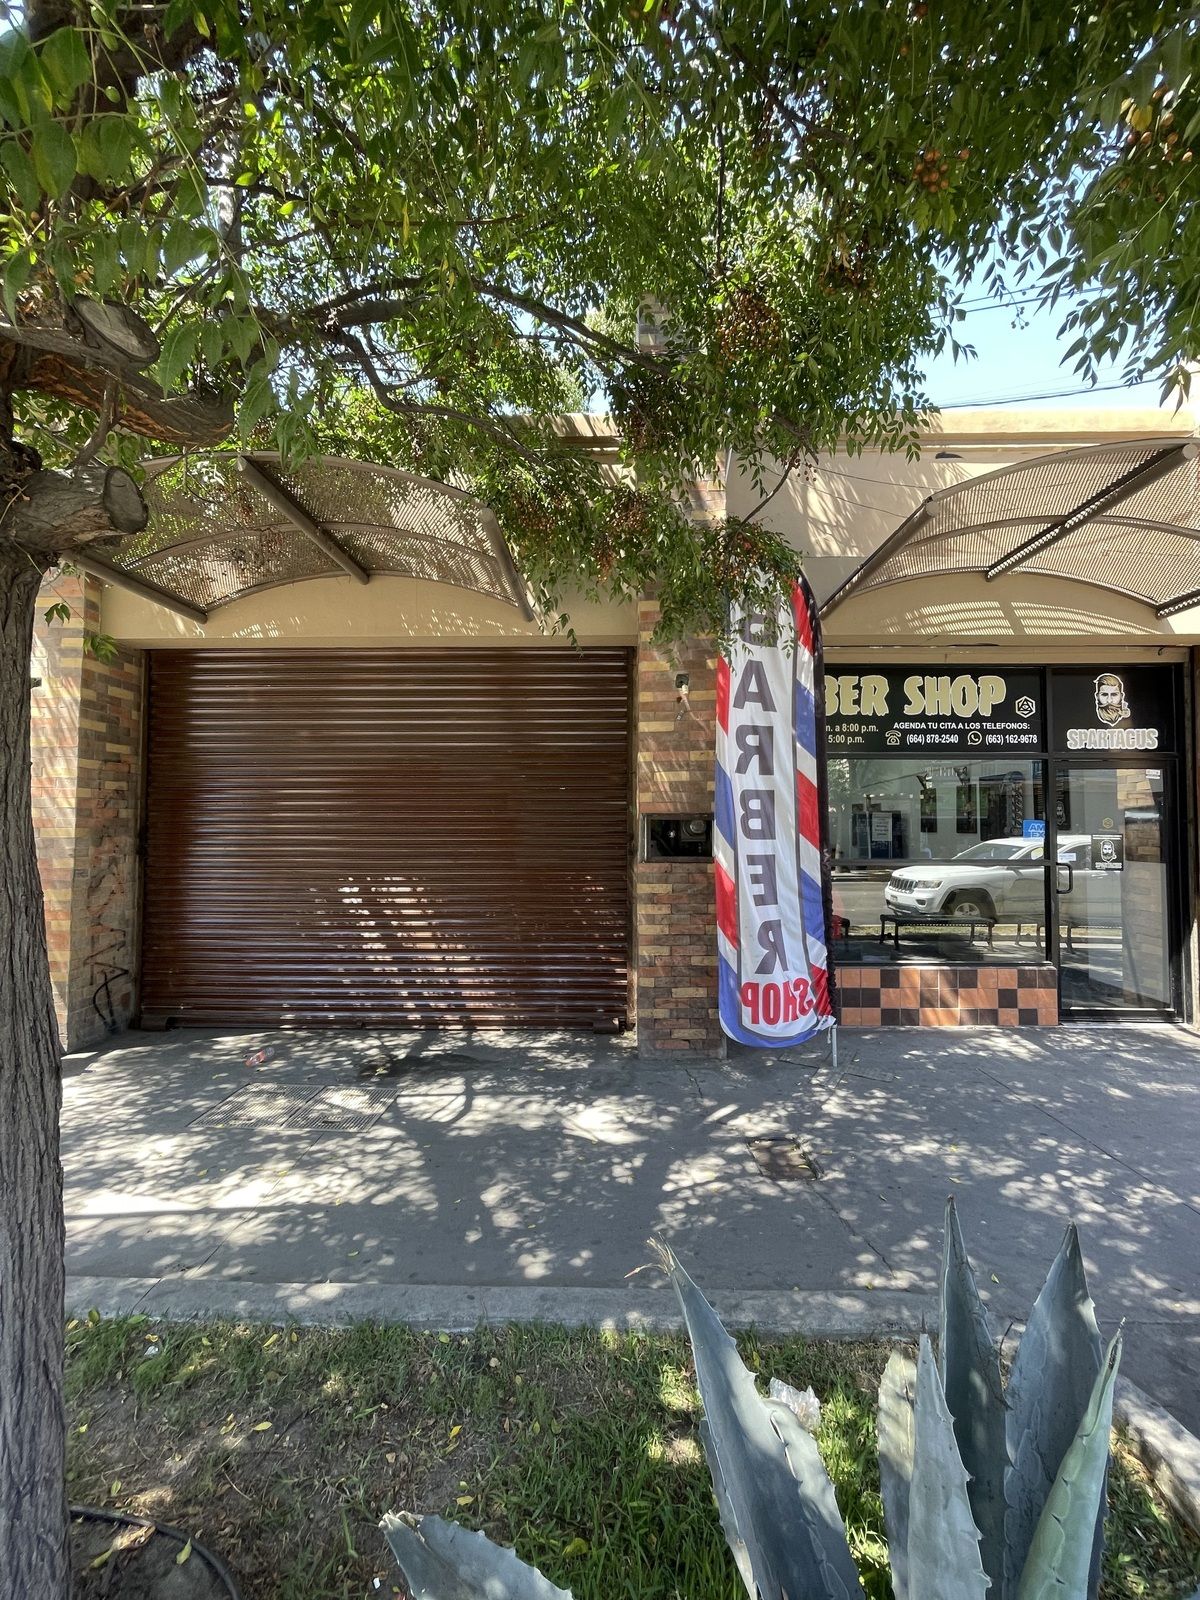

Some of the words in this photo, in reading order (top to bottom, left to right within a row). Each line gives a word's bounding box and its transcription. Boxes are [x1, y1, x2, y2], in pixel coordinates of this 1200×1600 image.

[903, 674, 1007, 718] SHOP
[842, 723, 859, 732] 8:00
[861, 725, 879, 734] p.m.
[893, 722, 926, 730] AGENDA
[927, 722, 938, 730] TU
[939, 722, 957, 730] CITA
[957, 722, 964, 730] A
[965, 722, 981, 730] LOS
[982, 722, 1031, 730] TELEFONOS:
[828, 734, 845, 743] 5:00
[847, 736, 865, 745] p.m.
[906, 734, 925, 745] (664)
[926, 734, 959, 744] 878-2540
[985, 734, 1004, 745] (663)
[1005, 734, 1038, 744] 162-9678
[1066, 728, 1159, 750] SPARTACUS
[1028, 823, 1045, 832] AM
